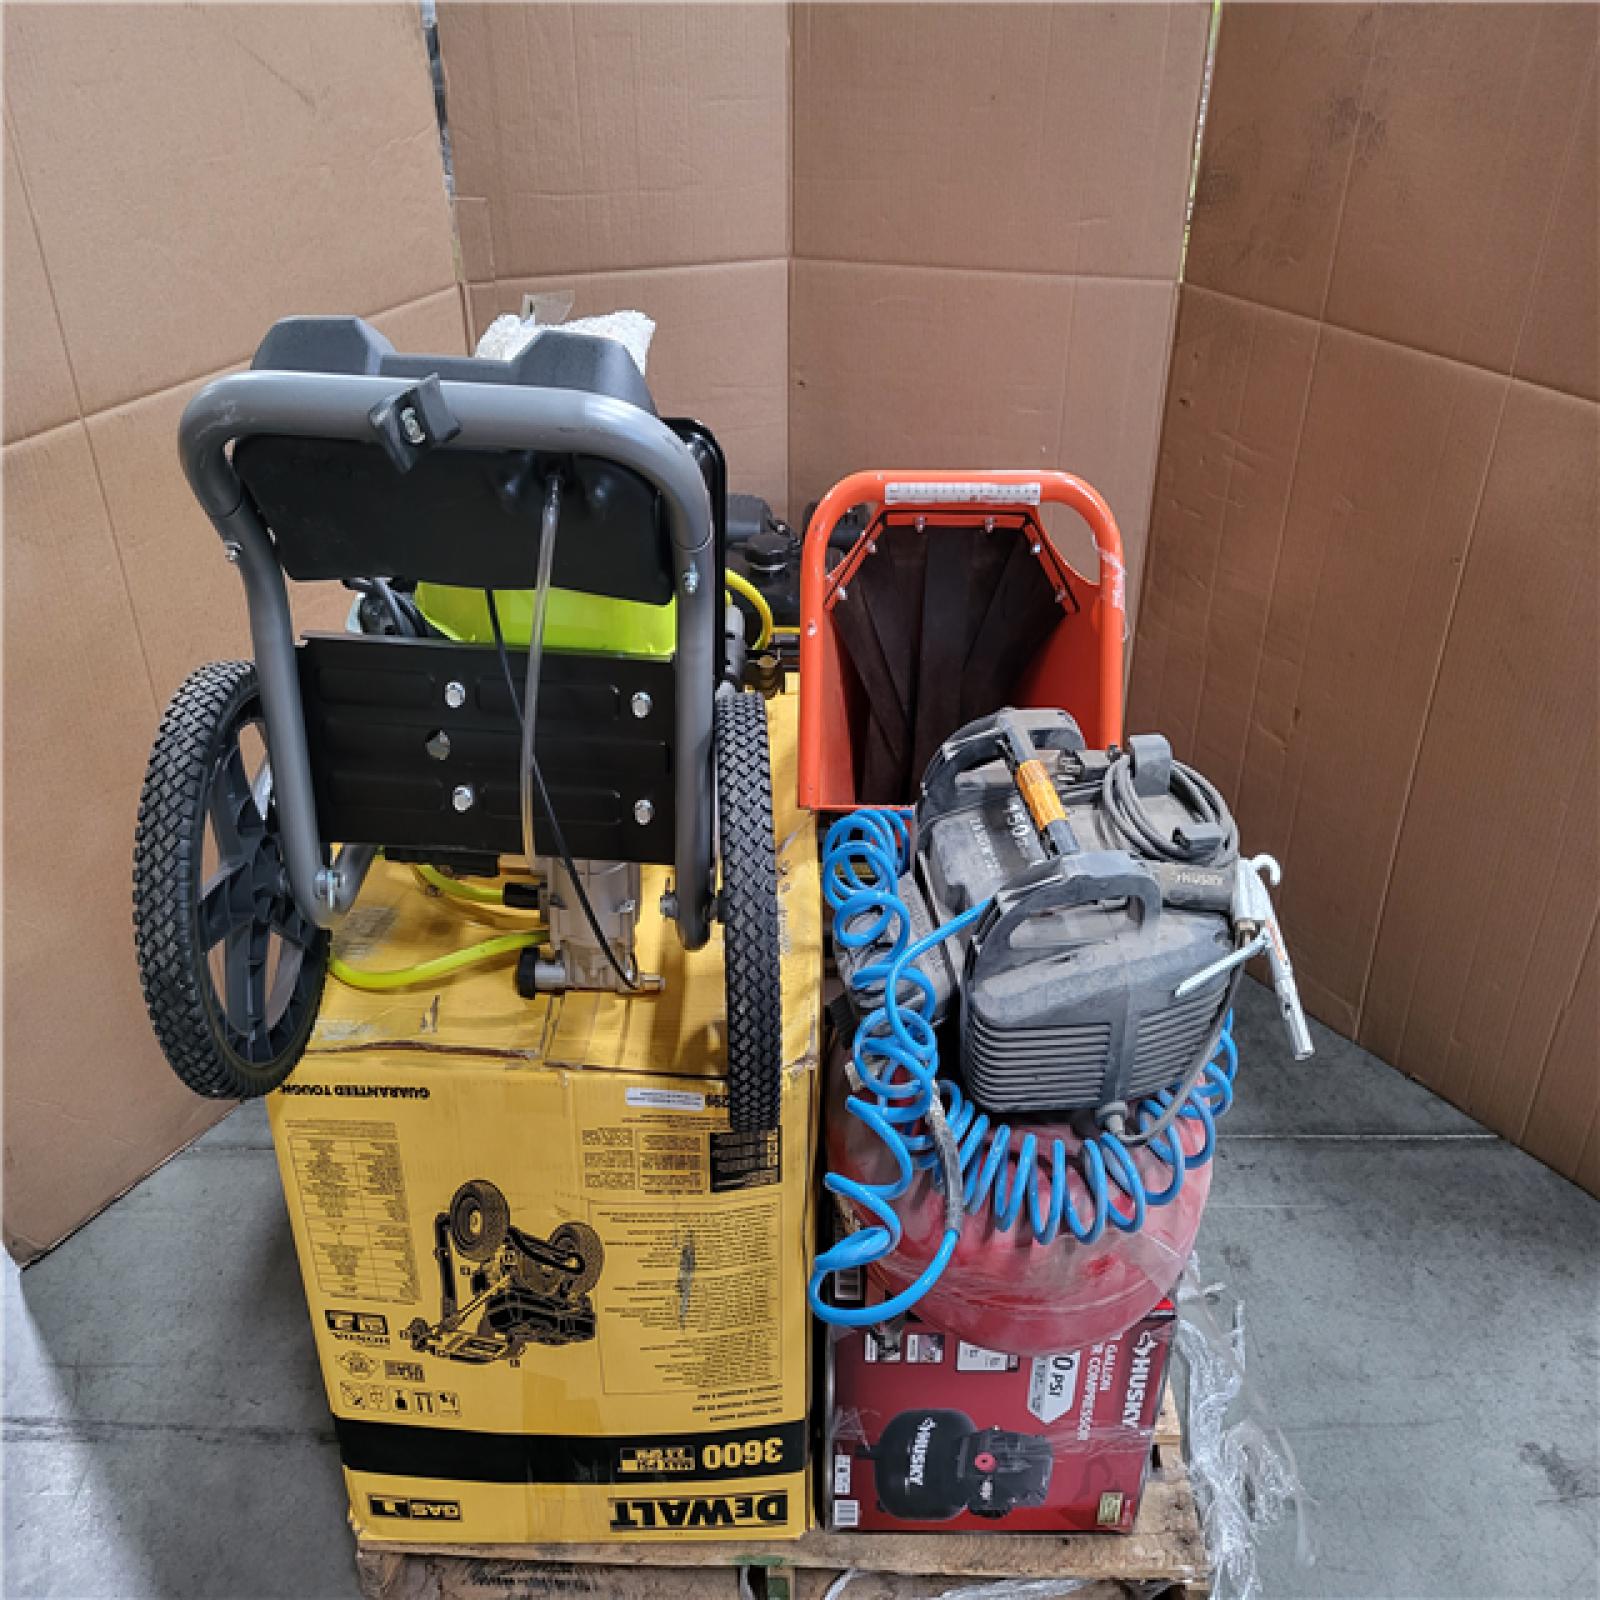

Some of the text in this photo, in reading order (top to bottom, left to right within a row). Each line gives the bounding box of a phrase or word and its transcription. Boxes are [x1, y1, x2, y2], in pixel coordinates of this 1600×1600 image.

[1053, 1356, 1074, 1371] 0
[1121, 1356, 1151, 1429] HUSKY
[702, 1437, 783, 1470] 3600
[908, 1429, 931, 1486] HUSKY
